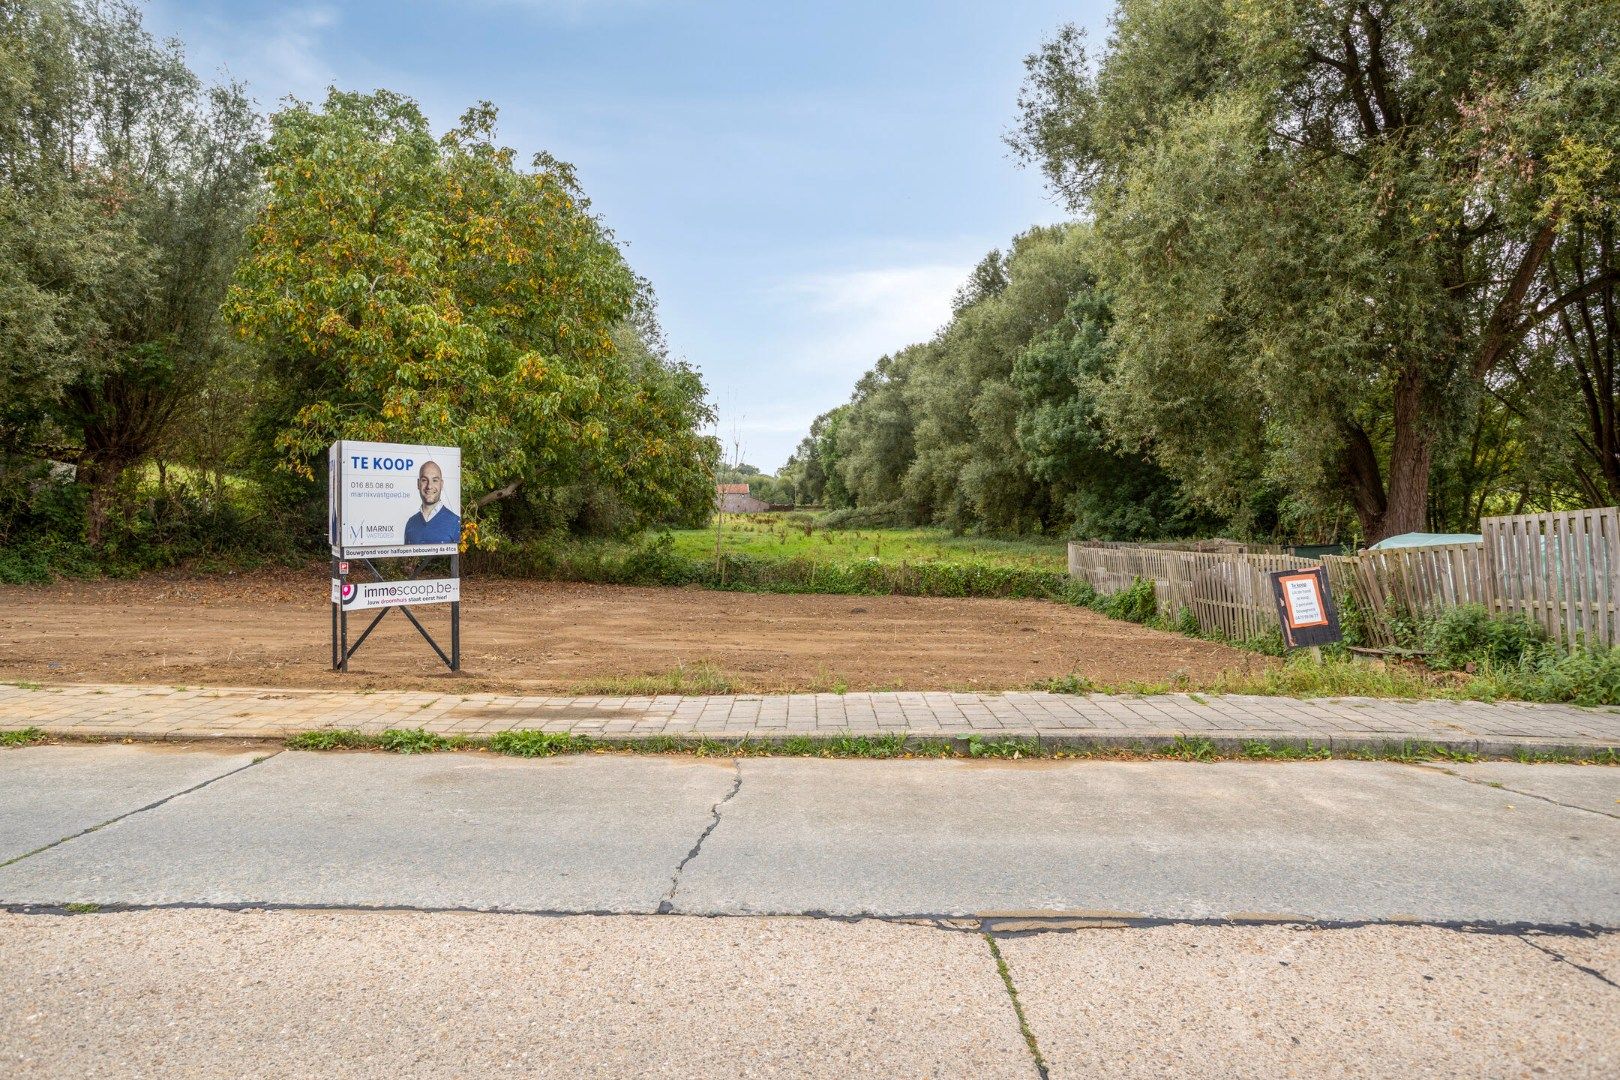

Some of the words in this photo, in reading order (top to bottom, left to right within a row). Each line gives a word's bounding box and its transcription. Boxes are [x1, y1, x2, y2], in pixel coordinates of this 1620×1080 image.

[351, 456, 369, 469] TE
[373, 457, 414, 471] KOOP
[350, 481, 363, 489] 016
[350, 490, 411, 500] marnixvastgoed.be
[366, 525, 394, 533] MARNIX
[345, 549, 377, 557] Bouwgrond
[390, 548, 412, 556] halfopen
[412, 546, 438, 554] bebouwing
[364, 582, 452, 598] immoscoop.be
[380, 597, 408, 605] droomhuis
